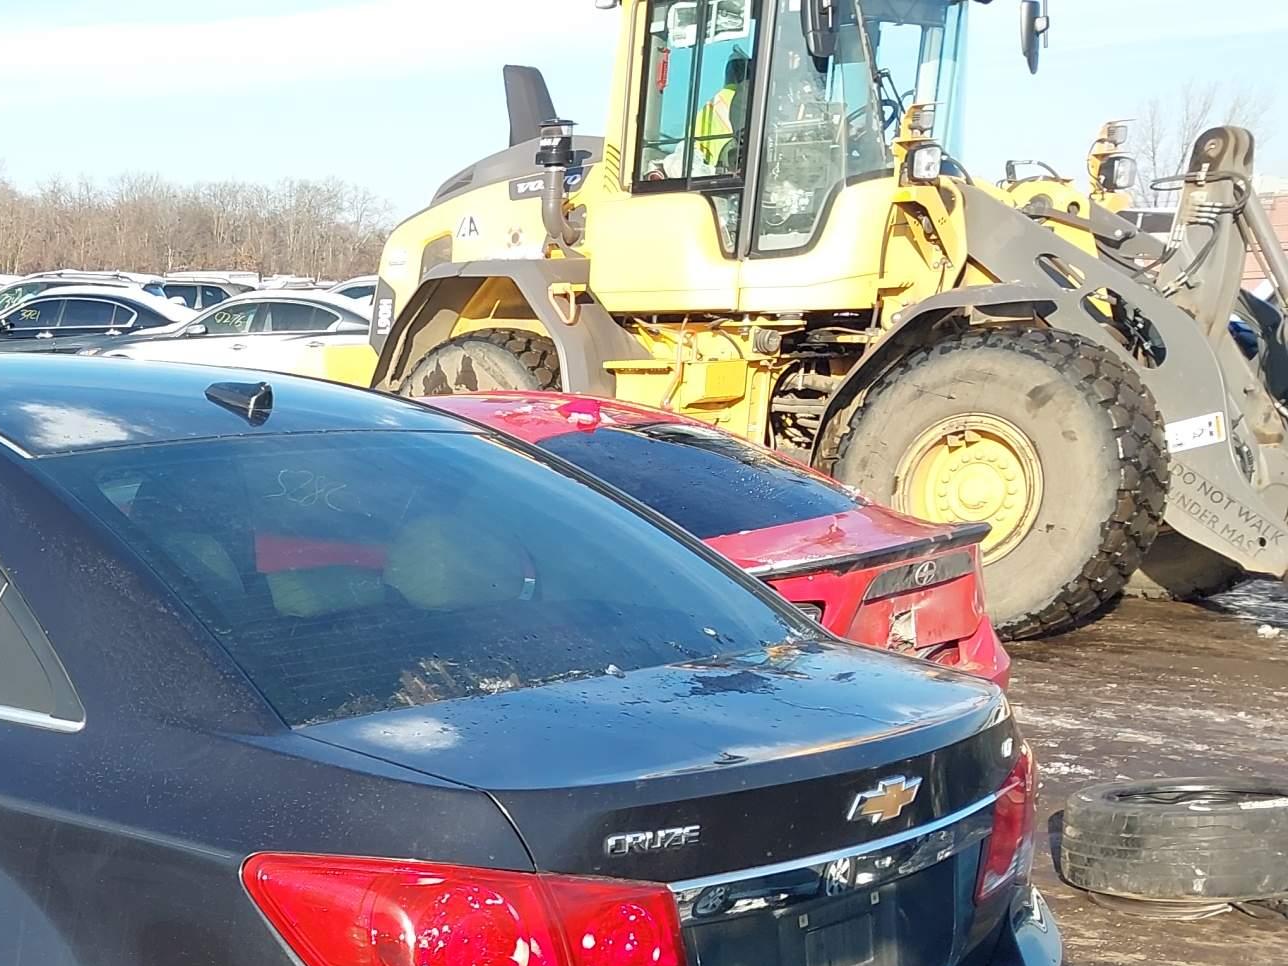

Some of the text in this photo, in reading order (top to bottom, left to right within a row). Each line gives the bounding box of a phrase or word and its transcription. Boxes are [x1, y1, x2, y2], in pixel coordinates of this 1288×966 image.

[377, 299, 393, 335] L90H
[1166, 486, 1219, 529] UNDER
[1170, 463, 1286, 546] DO NOT WALK
[605, 824, 702, 857] CRUZE
